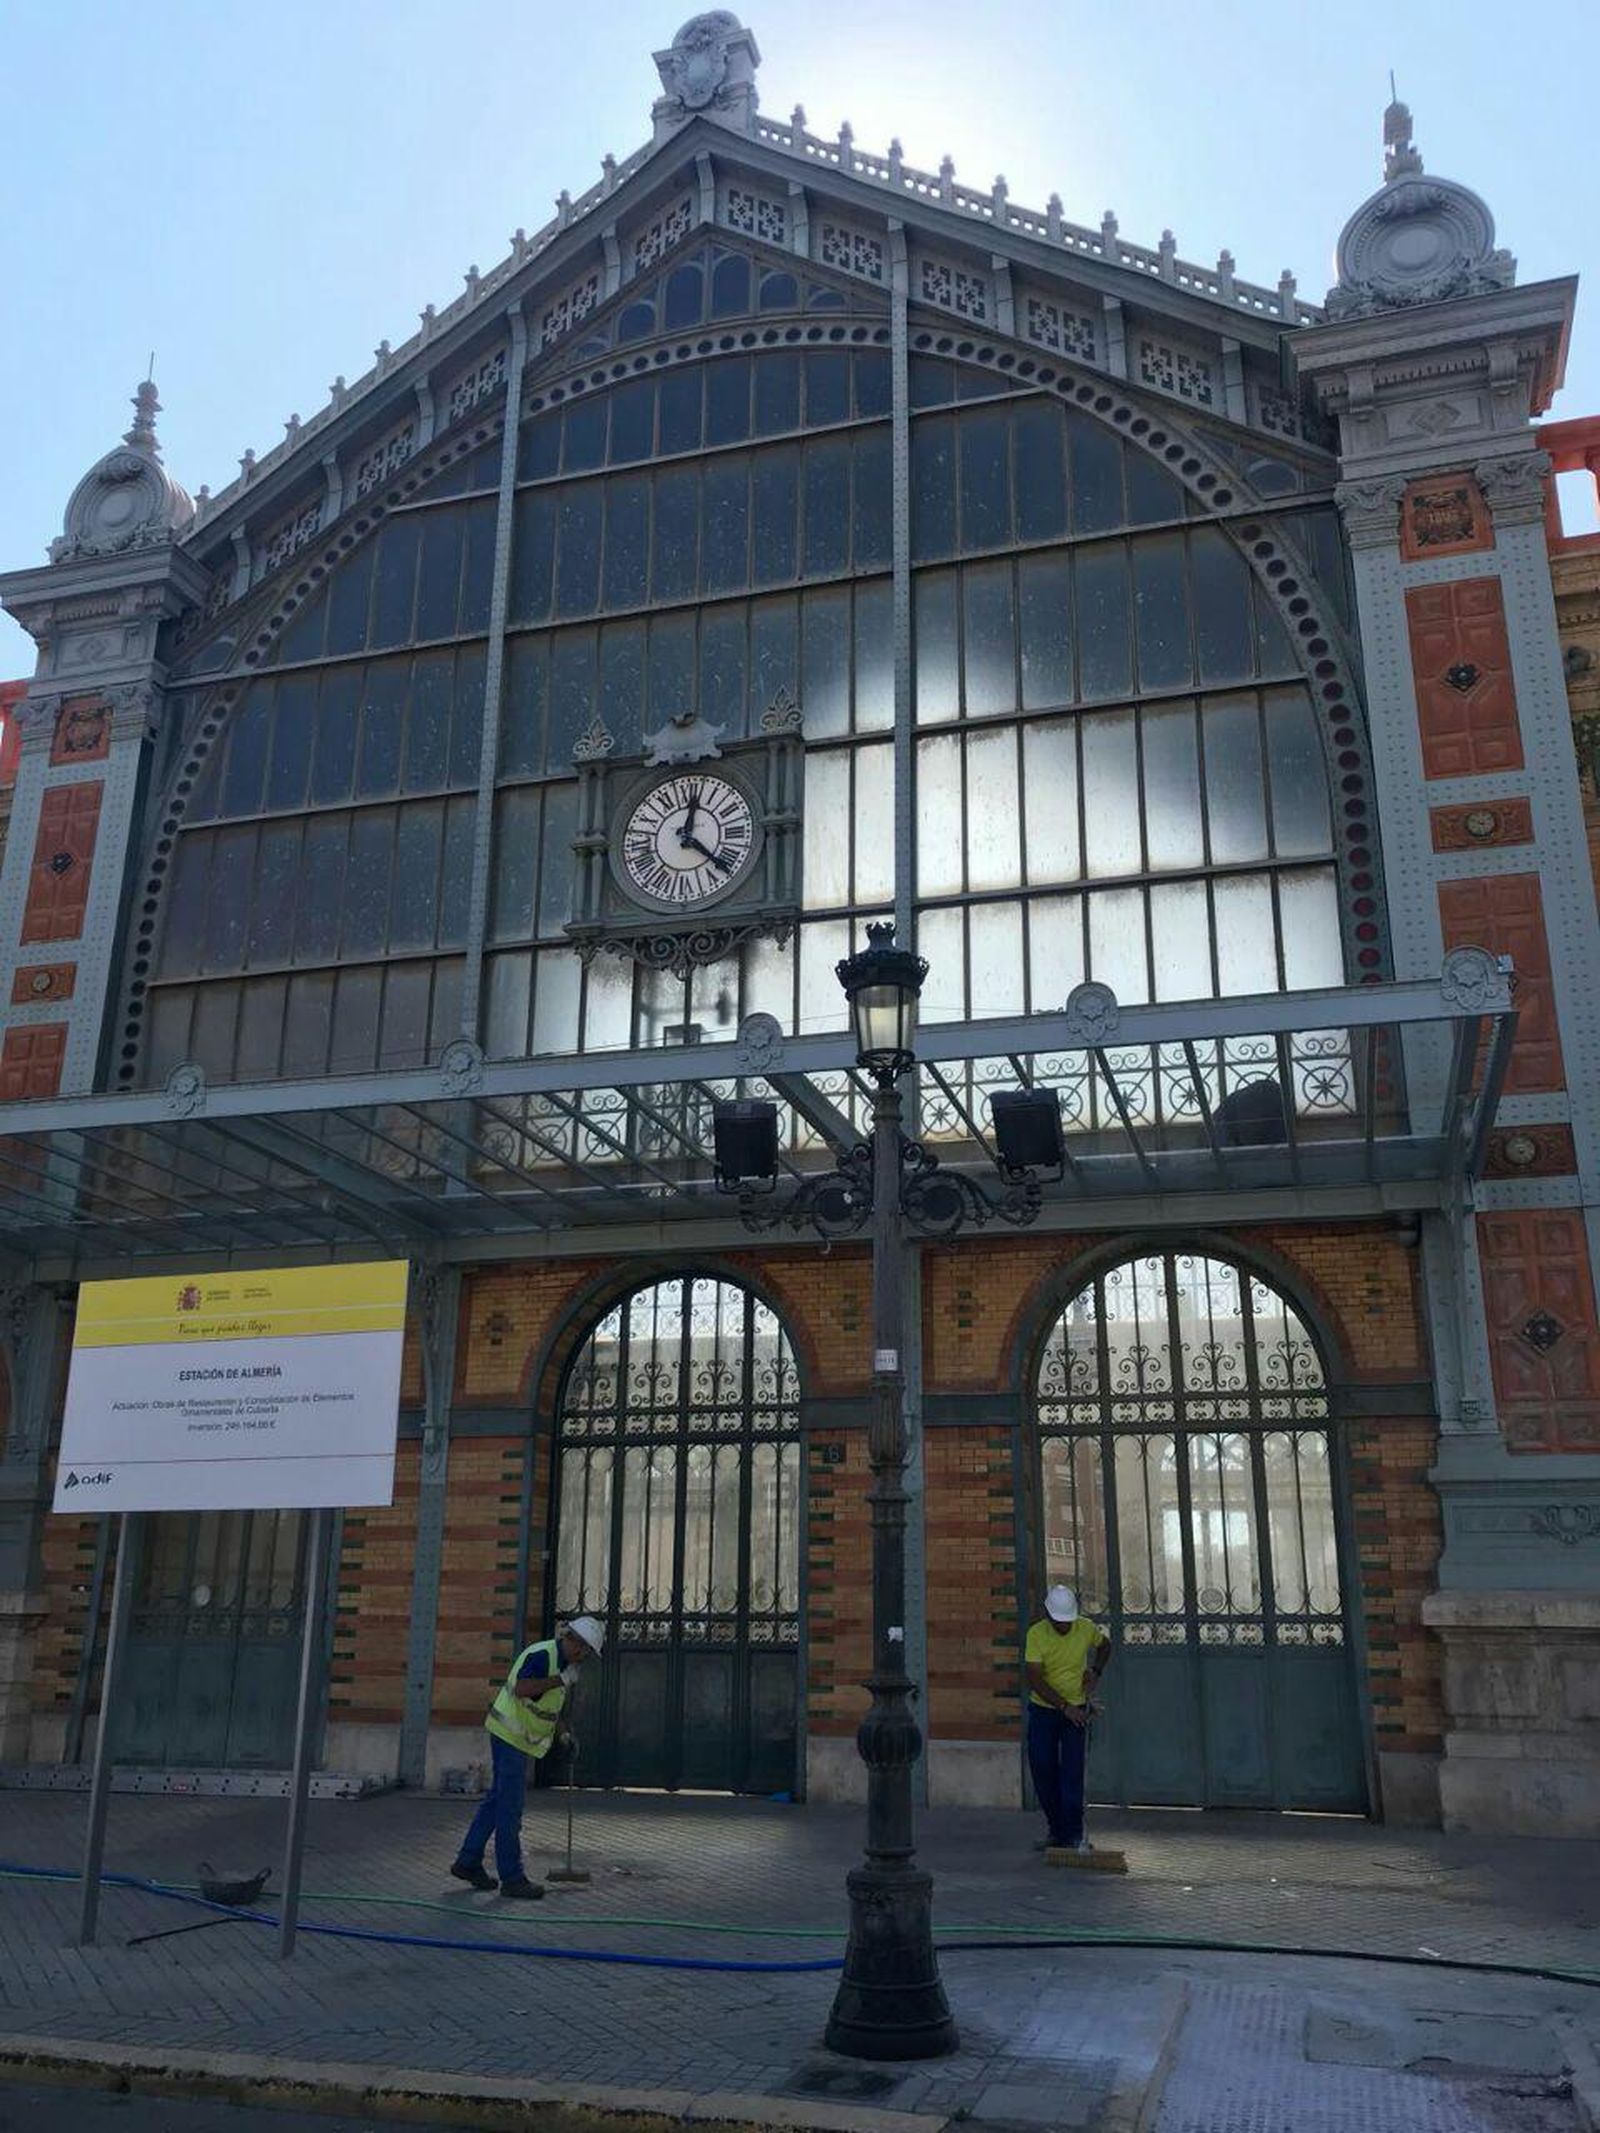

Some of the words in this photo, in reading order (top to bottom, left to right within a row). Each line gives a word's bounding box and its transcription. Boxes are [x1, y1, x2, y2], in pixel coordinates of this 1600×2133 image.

[724, 826, 745, 840] III
[180, 1368, 224, 1381] ESTACIÓN
[226, 1368, 239, 1379] DE
[241, 1365, 282, 1378] ALMERÍA
